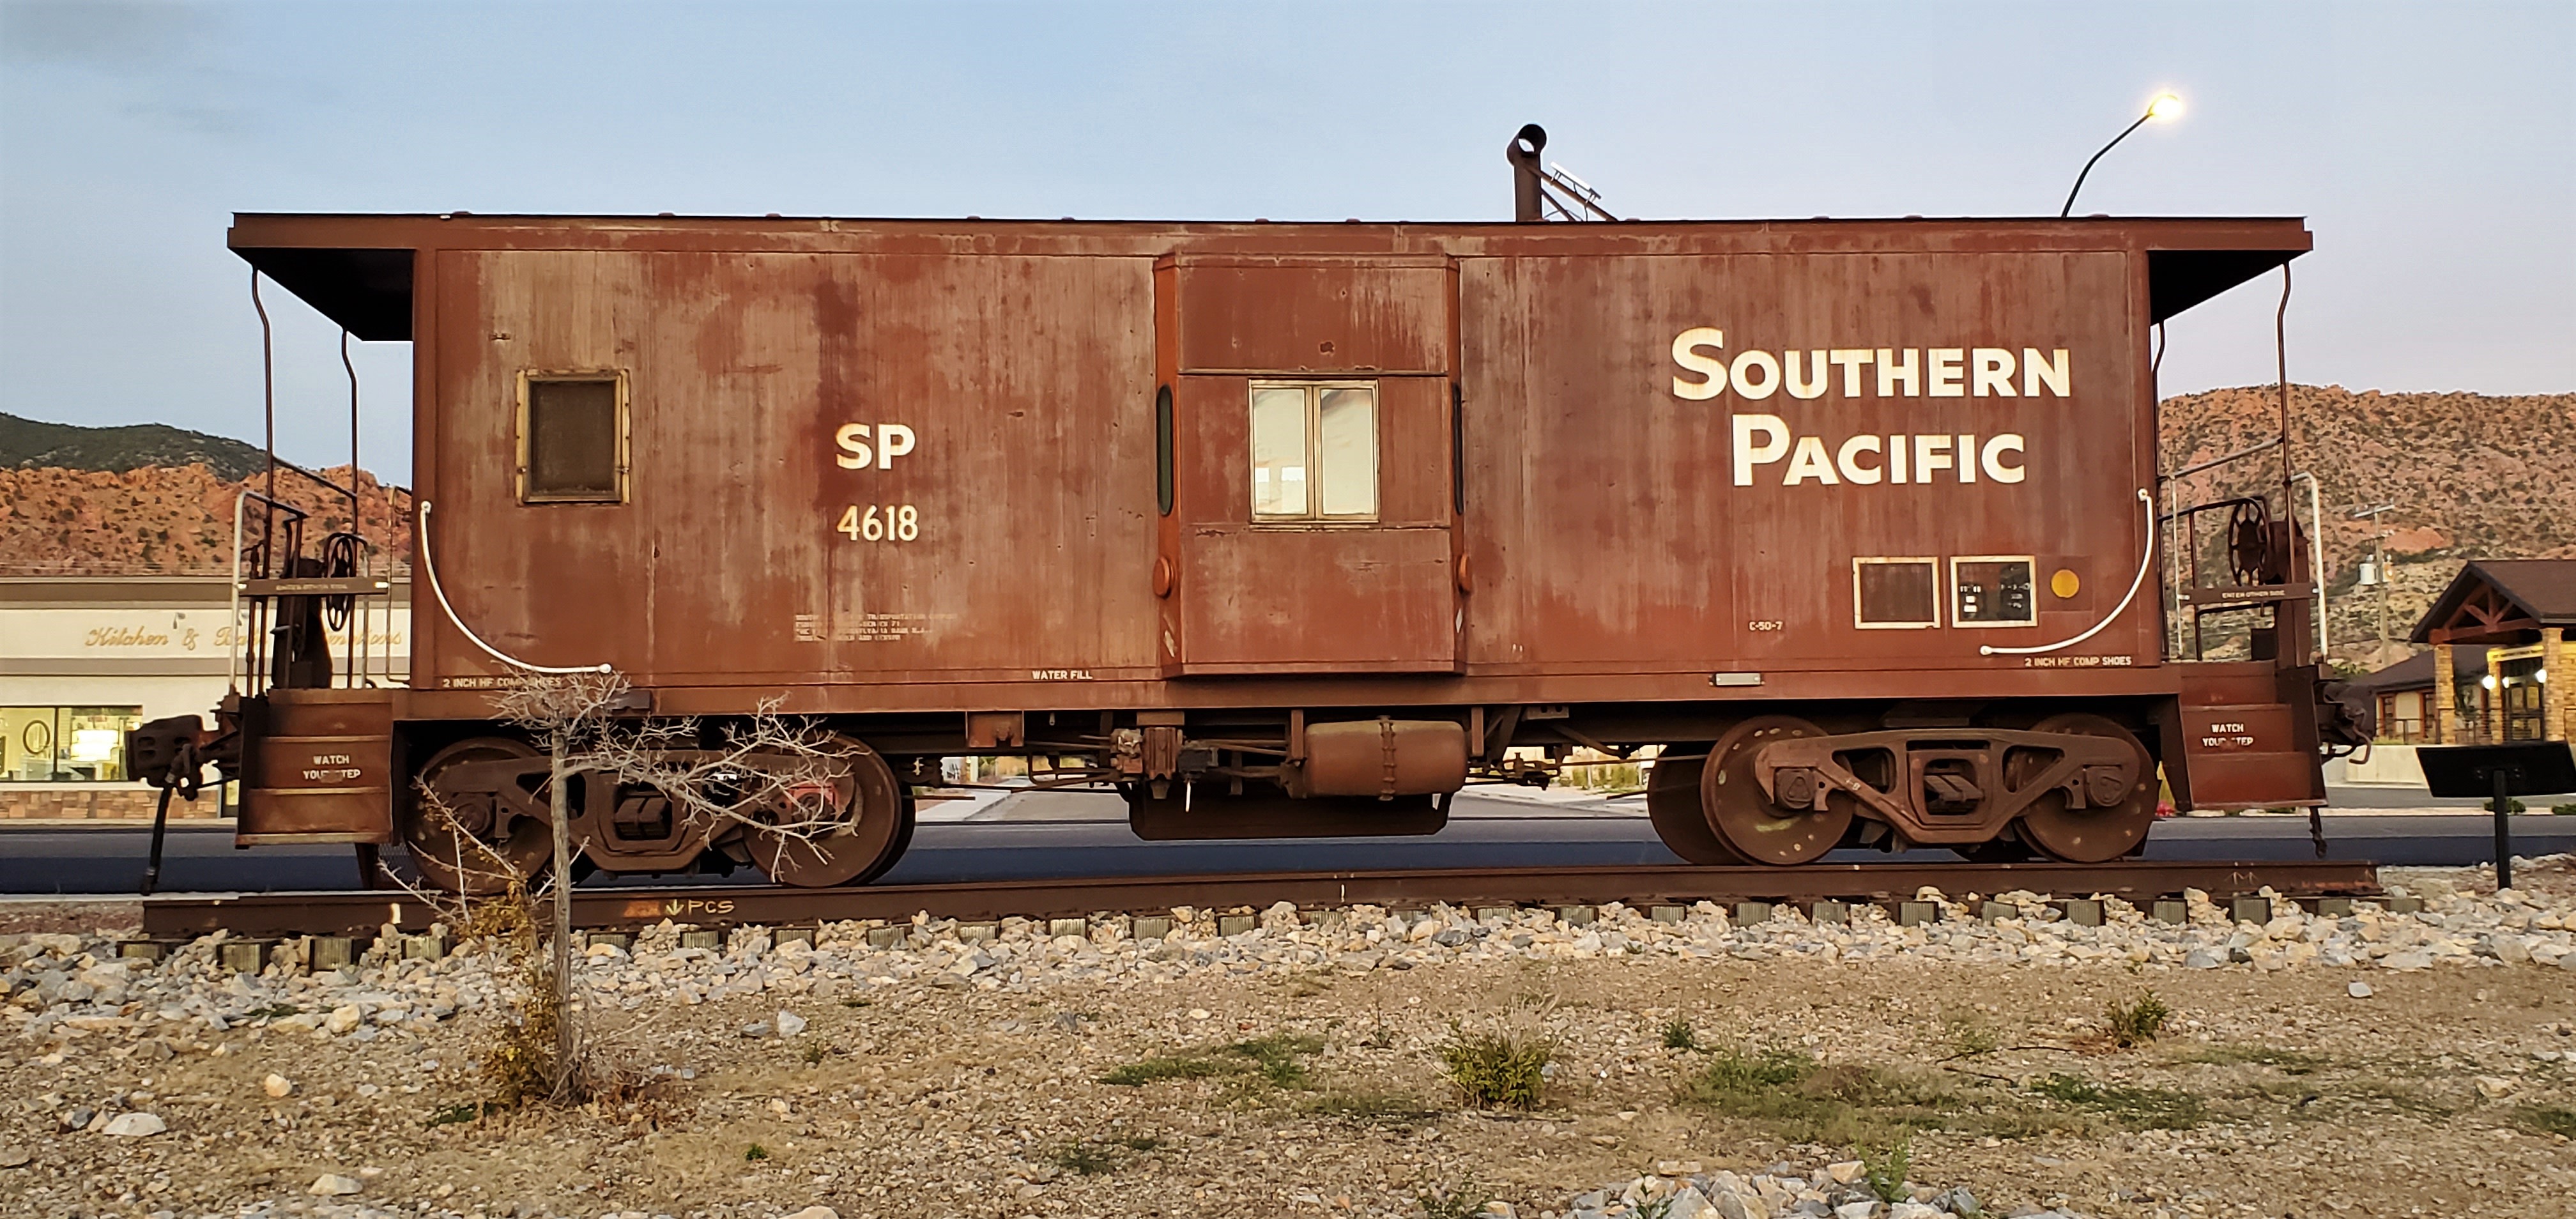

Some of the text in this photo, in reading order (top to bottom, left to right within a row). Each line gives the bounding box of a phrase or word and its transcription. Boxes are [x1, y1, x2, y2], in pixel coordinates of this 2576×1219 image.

[1671, 327, 2071, 400] SOUTHERN
[836, 423, 916, 470] SP
[1733, 414, 2025, 486] PACIFIC
[837, 505, 918, 541] 4618
[1749, 621, 1783, 631] C-50-7
[85, 625, 169, 647] Kitchen
[181, 628, 199, 650] &
[2025, 657, 2032, 667] 2
[2034, 657, 2055, 666] INCH
[2073, 657, 2099, 666] COMP
[2102, 656, 2132, 665] SHOES
[1032, 670, 1093, 680] WATER FILL
[443, 678, 450, 687] 2
[454, 678, 477, 687] INCH
[2211, 723, 2244, 733] WATCH
[2231, 737, 2253, 746] TEP
[313, 755, 349, 765] WATCH
[335, 769, 361, 778] TEP
[688, 900, 734, 915] PCS
